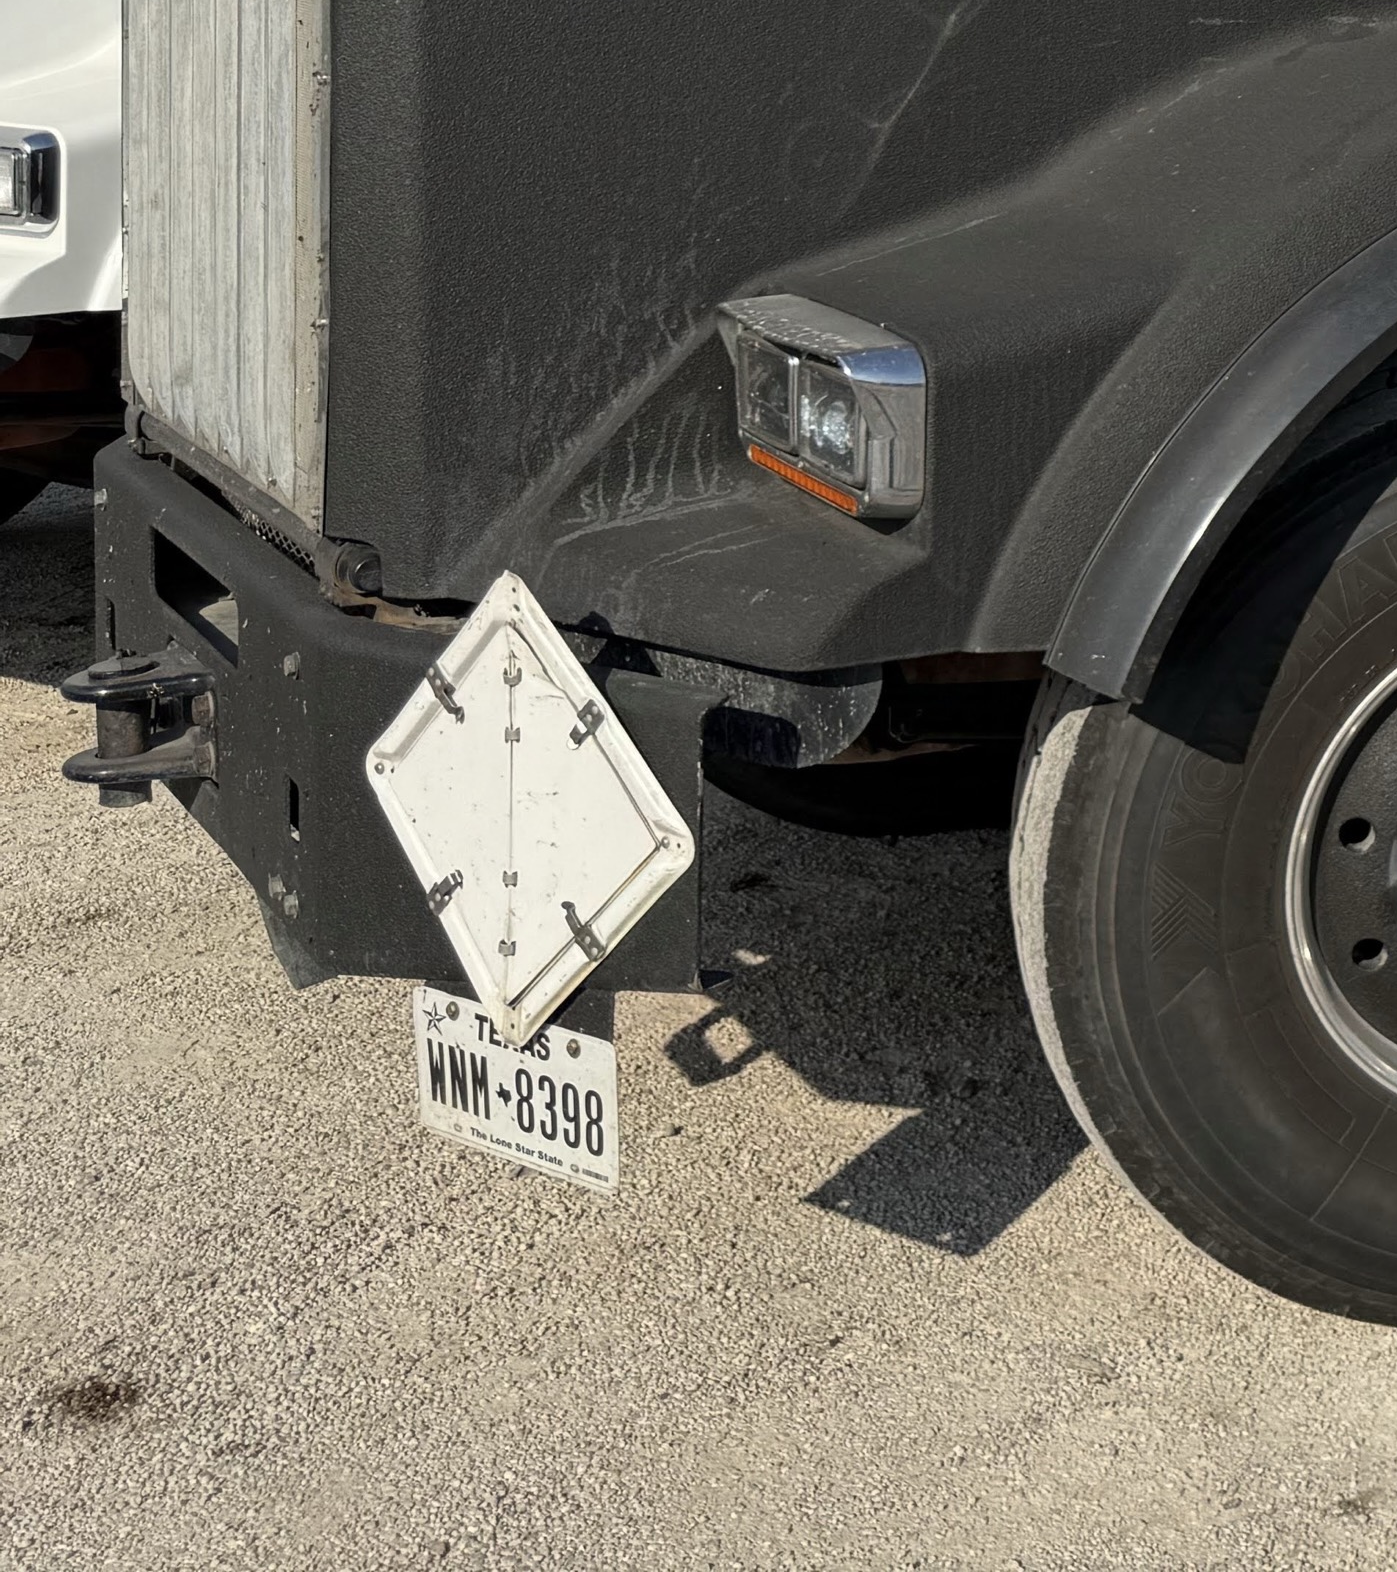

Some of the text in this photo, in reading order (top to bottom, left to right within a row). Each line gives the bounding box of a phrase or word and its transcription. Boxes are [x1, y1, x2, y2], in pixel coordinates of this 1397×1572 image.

[426, 1037, 604, 1157] WNM 8398
[470, 1127, 564, 1167] The Lone Star State
